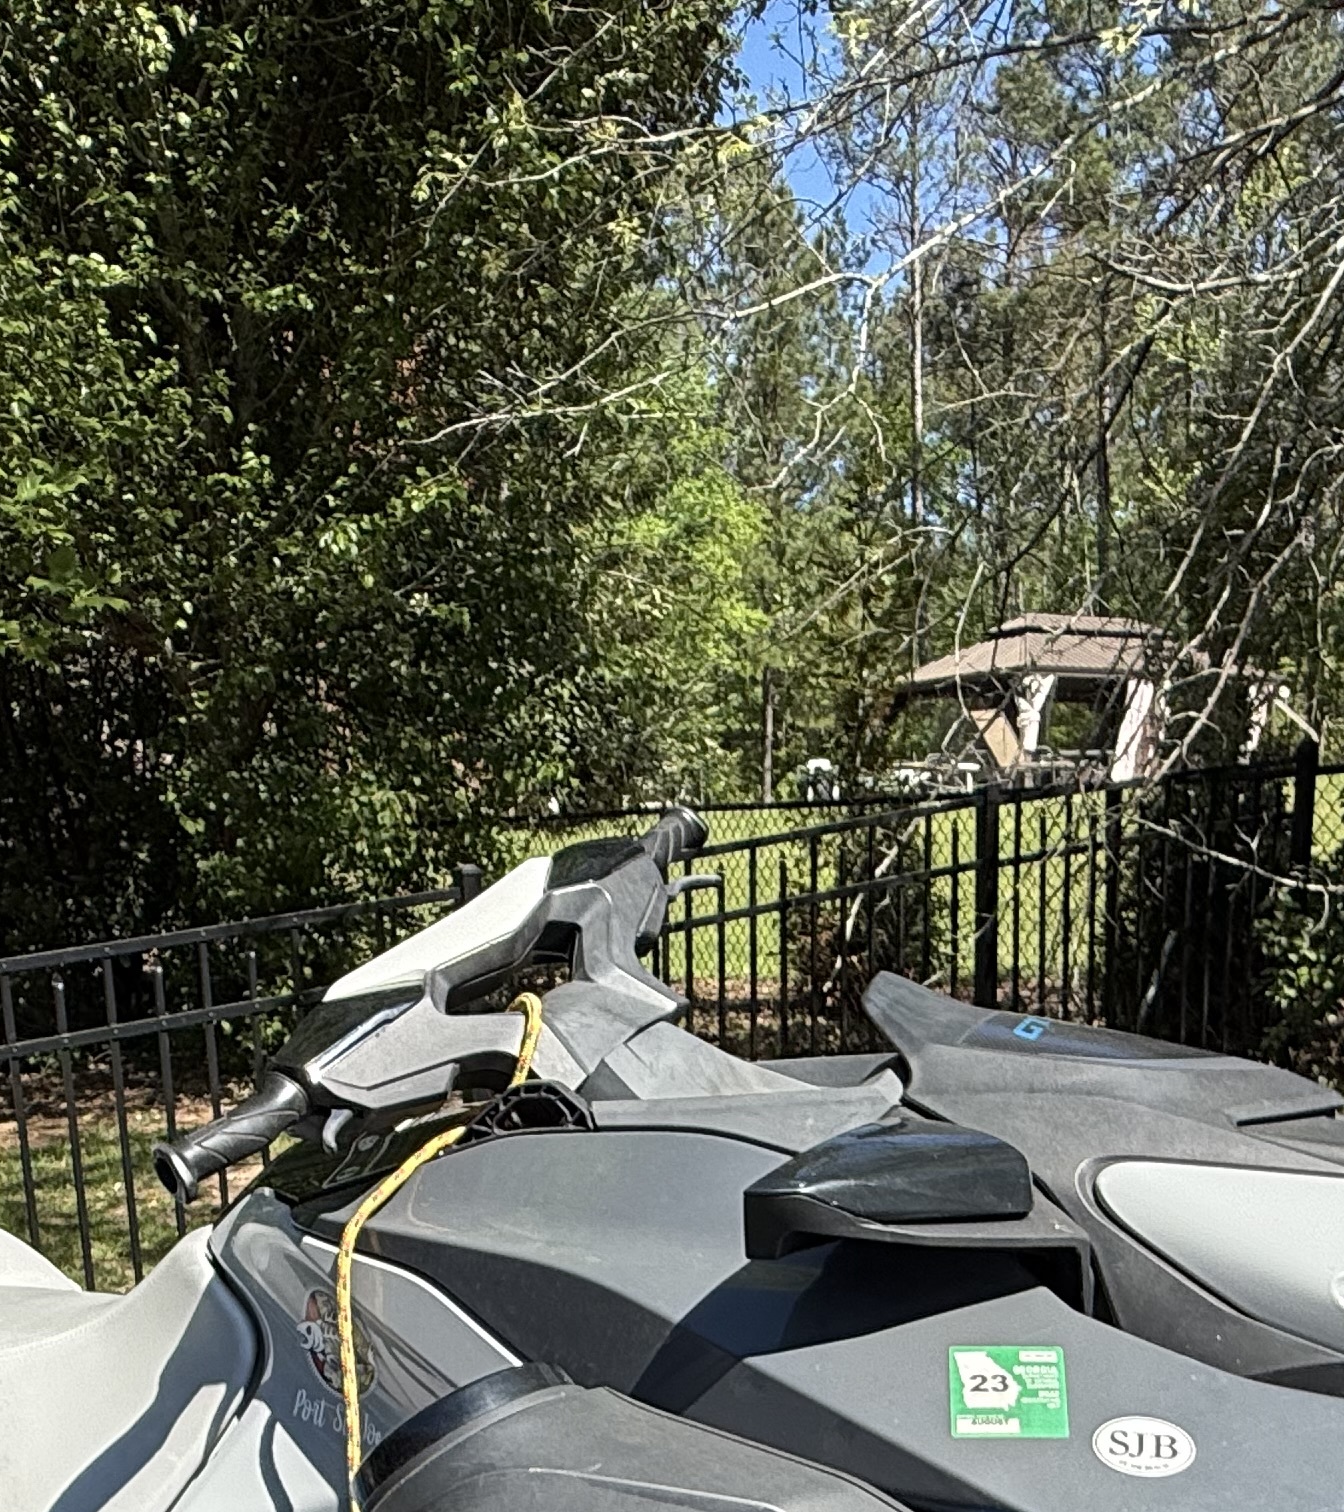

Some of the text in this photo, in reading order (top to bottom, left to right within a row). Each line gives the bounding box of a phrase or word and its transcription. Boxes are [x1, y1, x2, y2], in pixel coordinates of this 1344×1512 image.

[969, 1374, 1009, 1393] 23
[293, 1388, 326, 1427] Port
[1109, 1430, 1178, 1459] SJB
